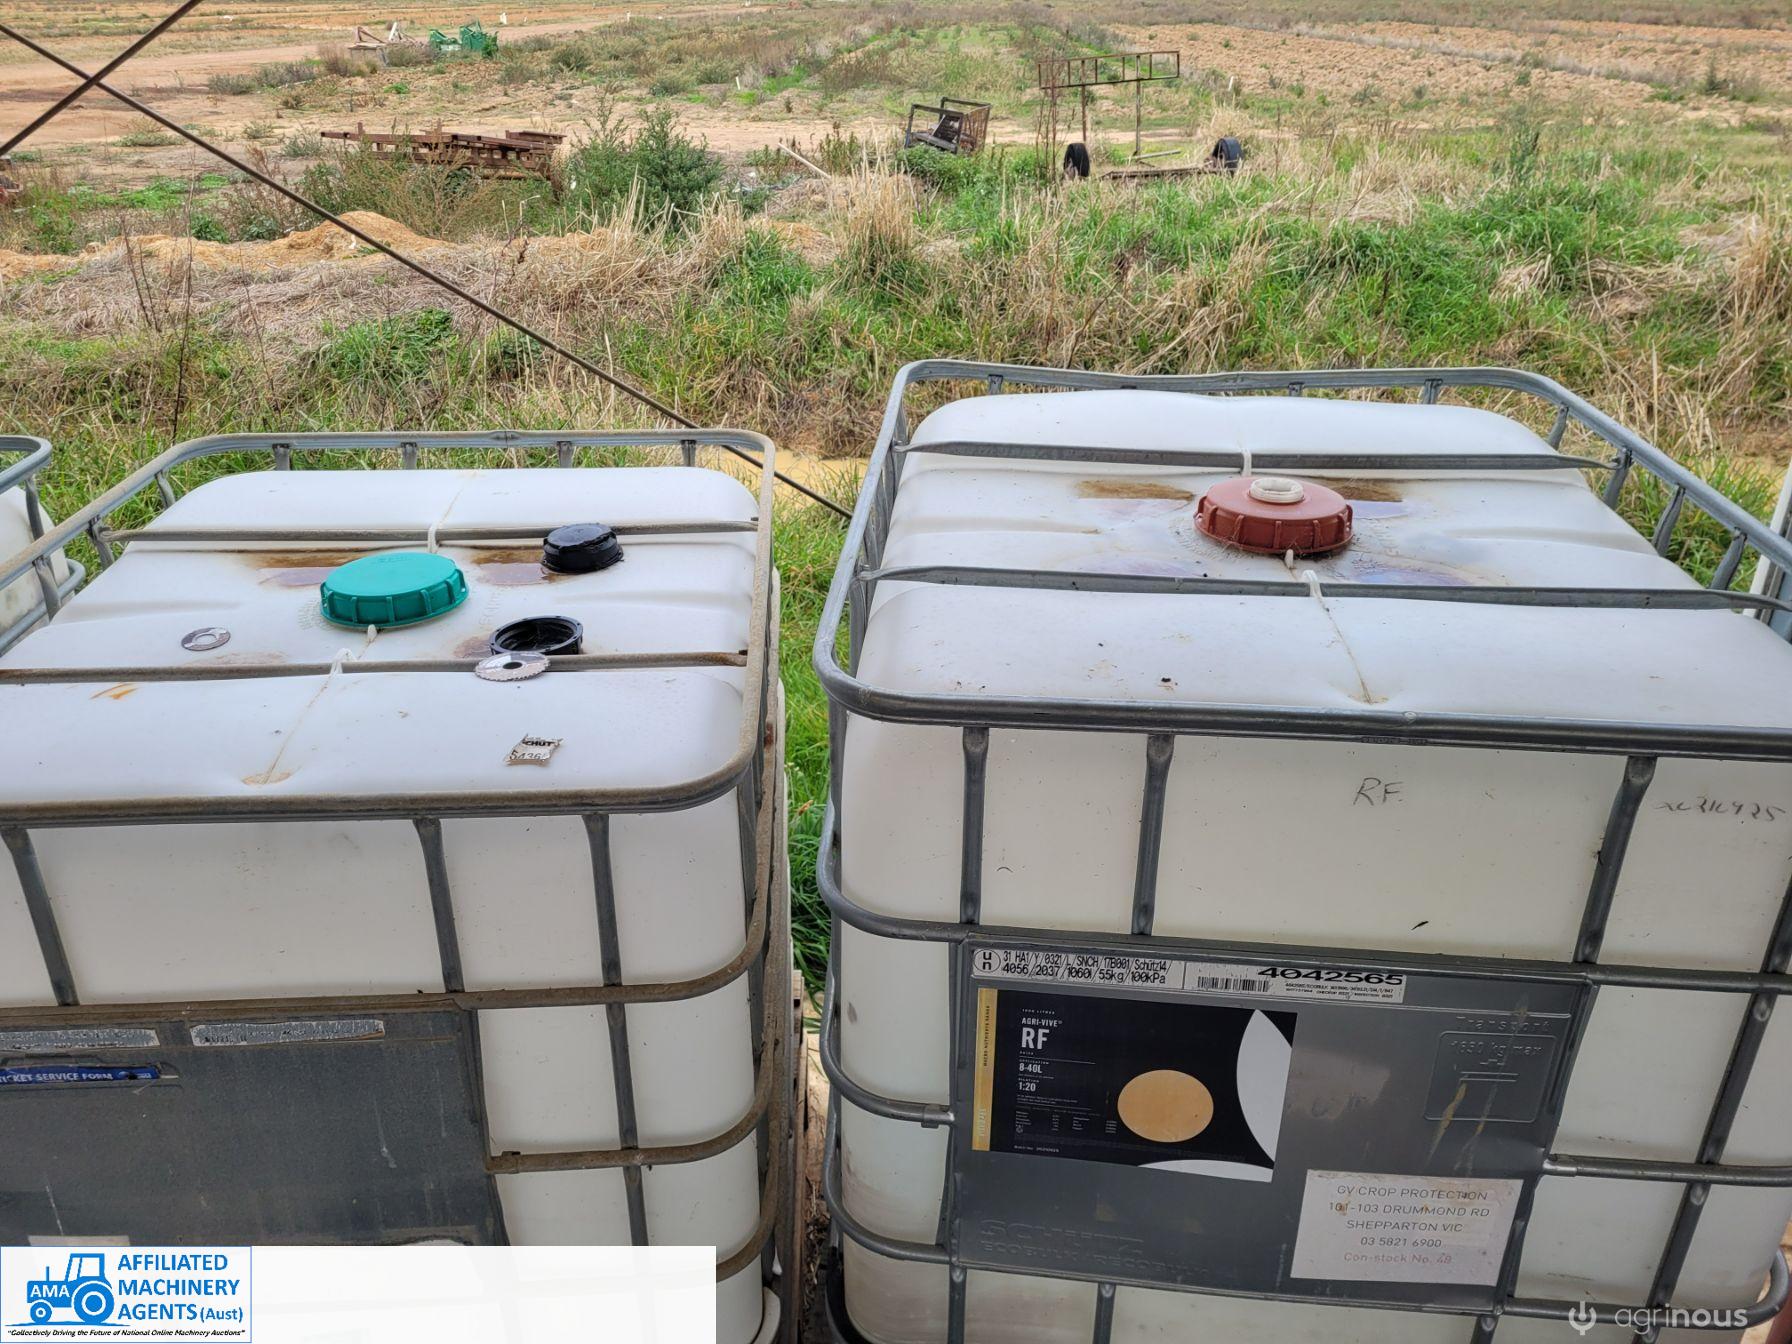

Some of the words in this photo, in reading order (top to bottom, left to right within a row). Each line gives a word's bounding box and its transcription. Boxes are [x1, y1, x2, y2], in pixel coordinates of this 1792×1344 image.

[1353, 777, 1404, 806] RF
[1003, 950, 1012, 962] 31
[1258, 967, 1404, 986] 4042565
[1021, 1027, 1050, 1050] RF
[1019, 1062, 1043, 1074] 8-40L
[35, 1073, 79, 1081] SERVICE
[1018, 1082, 1037, 1092] 1:20
[1337, 1185, 1354, 1195] GV
[1358, 1186, 1397, 1197] CROP
[1400, 1188, 1488, 1200] PROTECTION
[1383, 1204, 1466, 1217] DRUMMOND
[1470, 1207, 1490, 1217] RD
[1346, 1219, 1438, 1232] SHEPPARTON
[1442, 1223, 1464, 1233] VIC
[1360, 1236, 1375, 1246] 03
[1379, 1237, 1407, 1247] 5821
[1412, 1238, 1442, 1248] 6900
[1344, 1252, 1408, 1264] Con-stock
